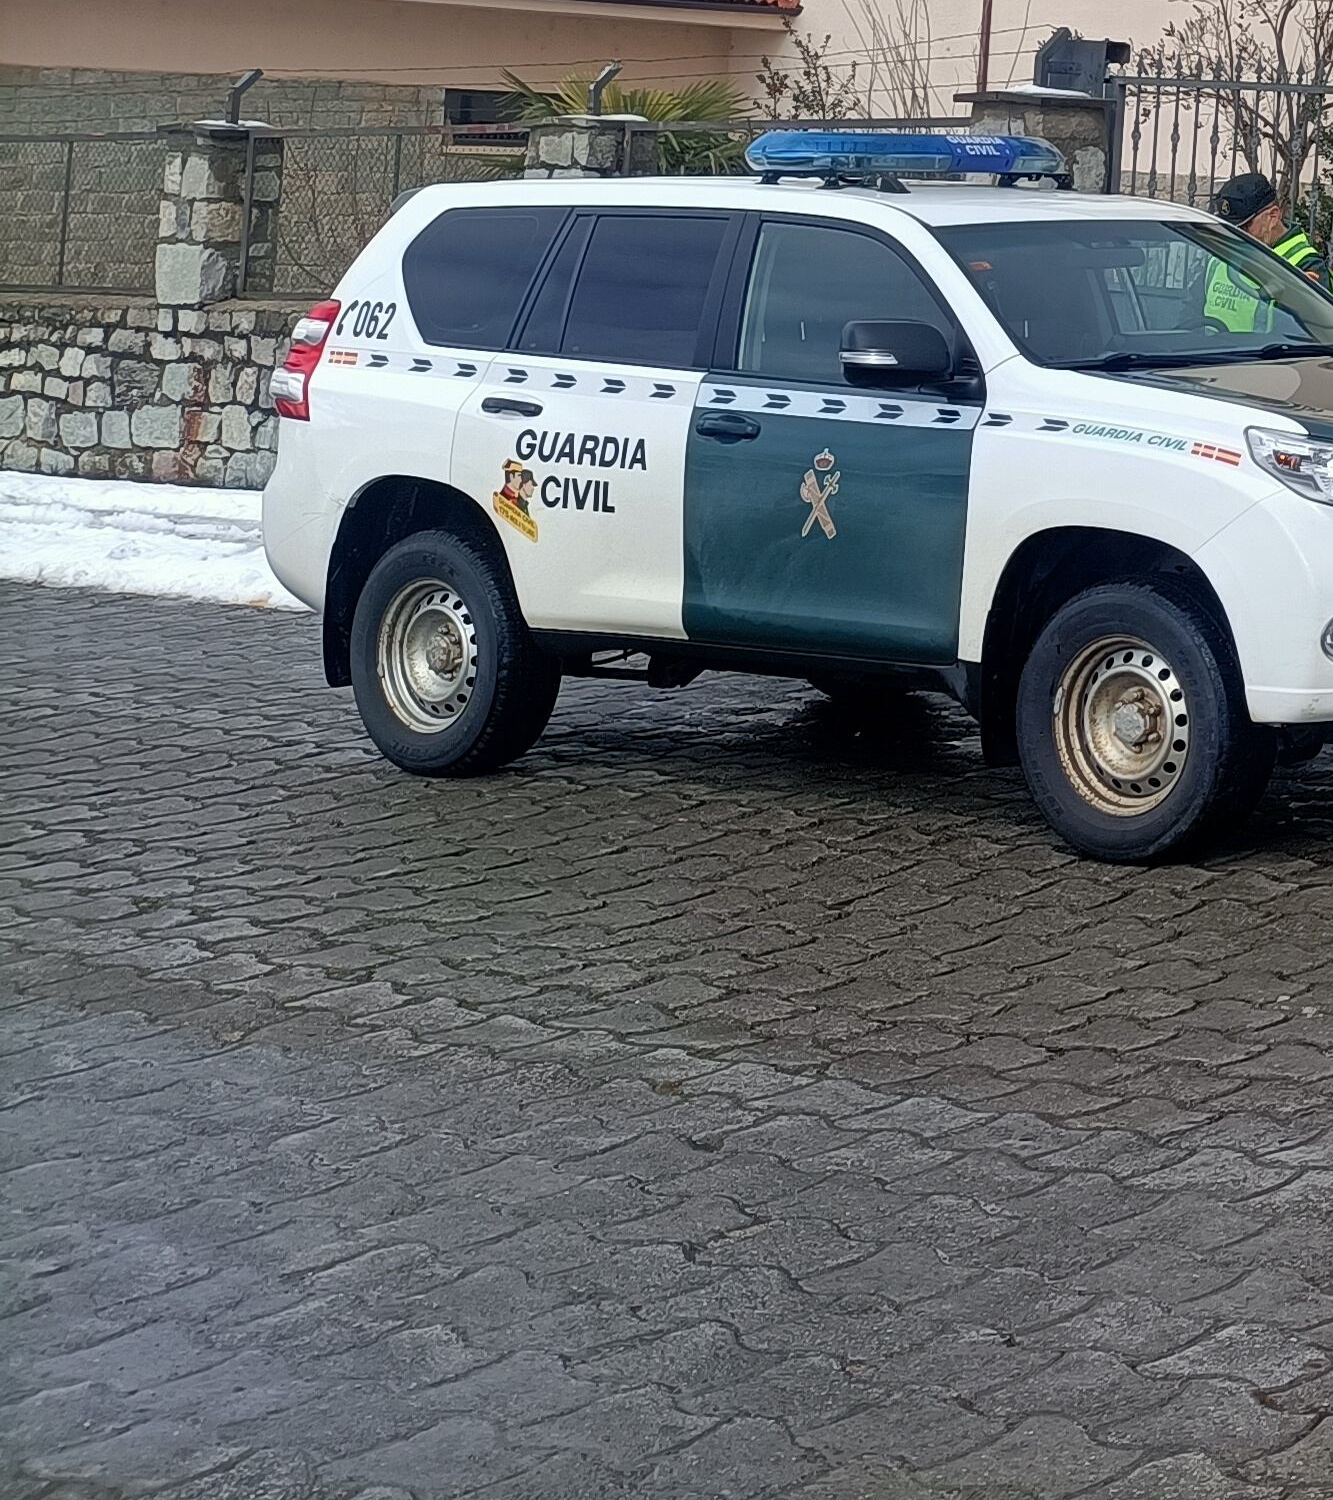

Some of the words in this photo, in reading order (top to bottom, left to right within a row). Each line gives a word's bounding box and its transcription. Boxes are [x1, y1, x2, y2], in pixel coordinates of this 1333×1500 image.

[945, 135, 1006, 145] GUARDIA
[965, 145, 1001, 156] CIVIL
[353, 300, 397, 340] 062
[515, 429, 647, 471] GUARDIA
[1072, 423, 1144, 443] GUARDIA
[1147, 435, 1189, 451] CIVIL
[541, 475, 616, 513] CIVIL
